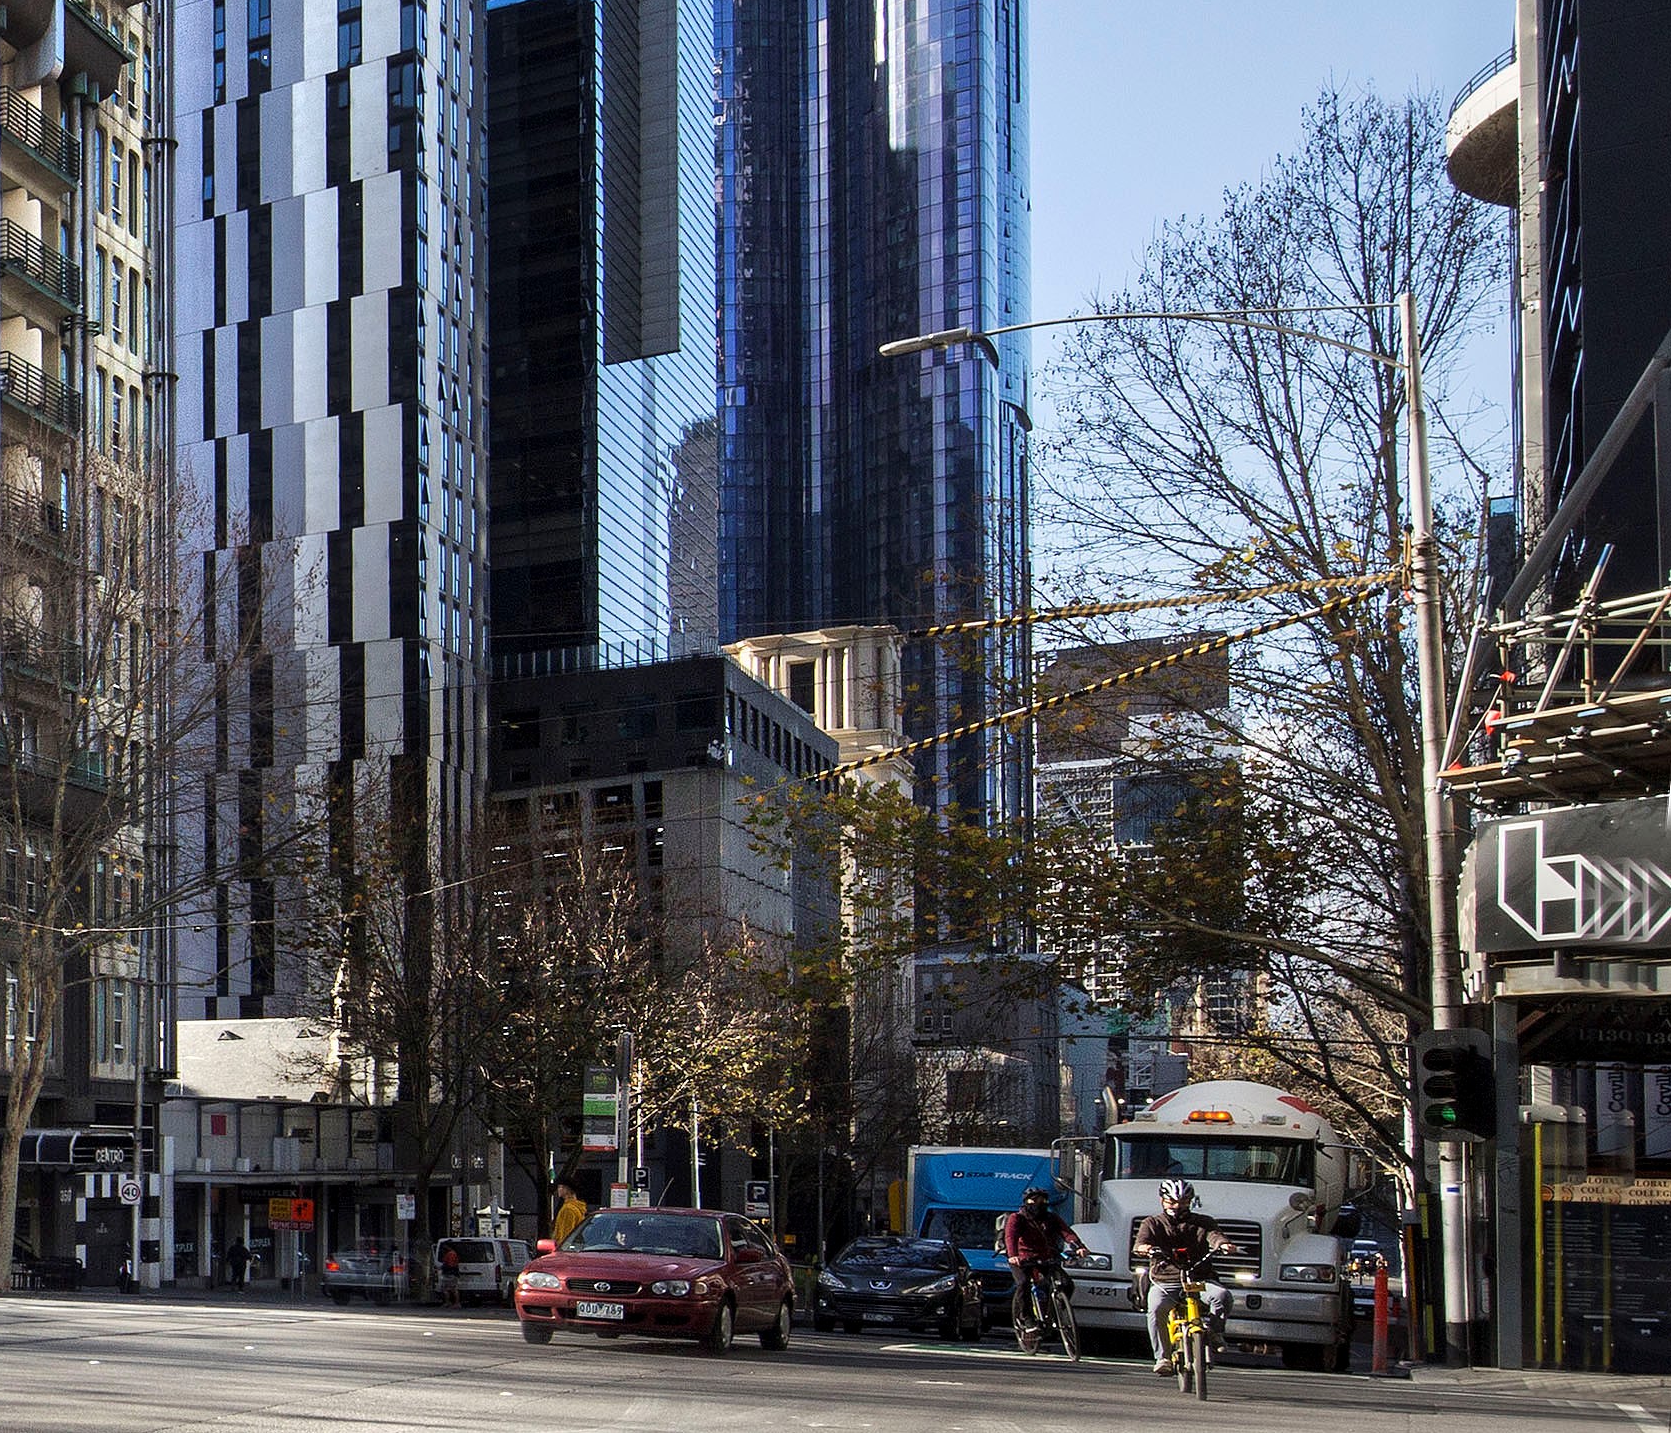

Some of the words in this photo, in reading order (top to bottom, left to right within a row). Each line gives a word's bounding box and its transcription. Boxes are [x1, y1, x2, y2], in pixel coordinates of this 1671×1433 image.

[635, 1169, 647, 1182] P
[966, 1172, 1034, 1181] STARTRACK
[123, 1187, 138, 1197] 40
[751, 1186, 767, 1200] P
[1088, 1286, 1118, 1296] 4221
